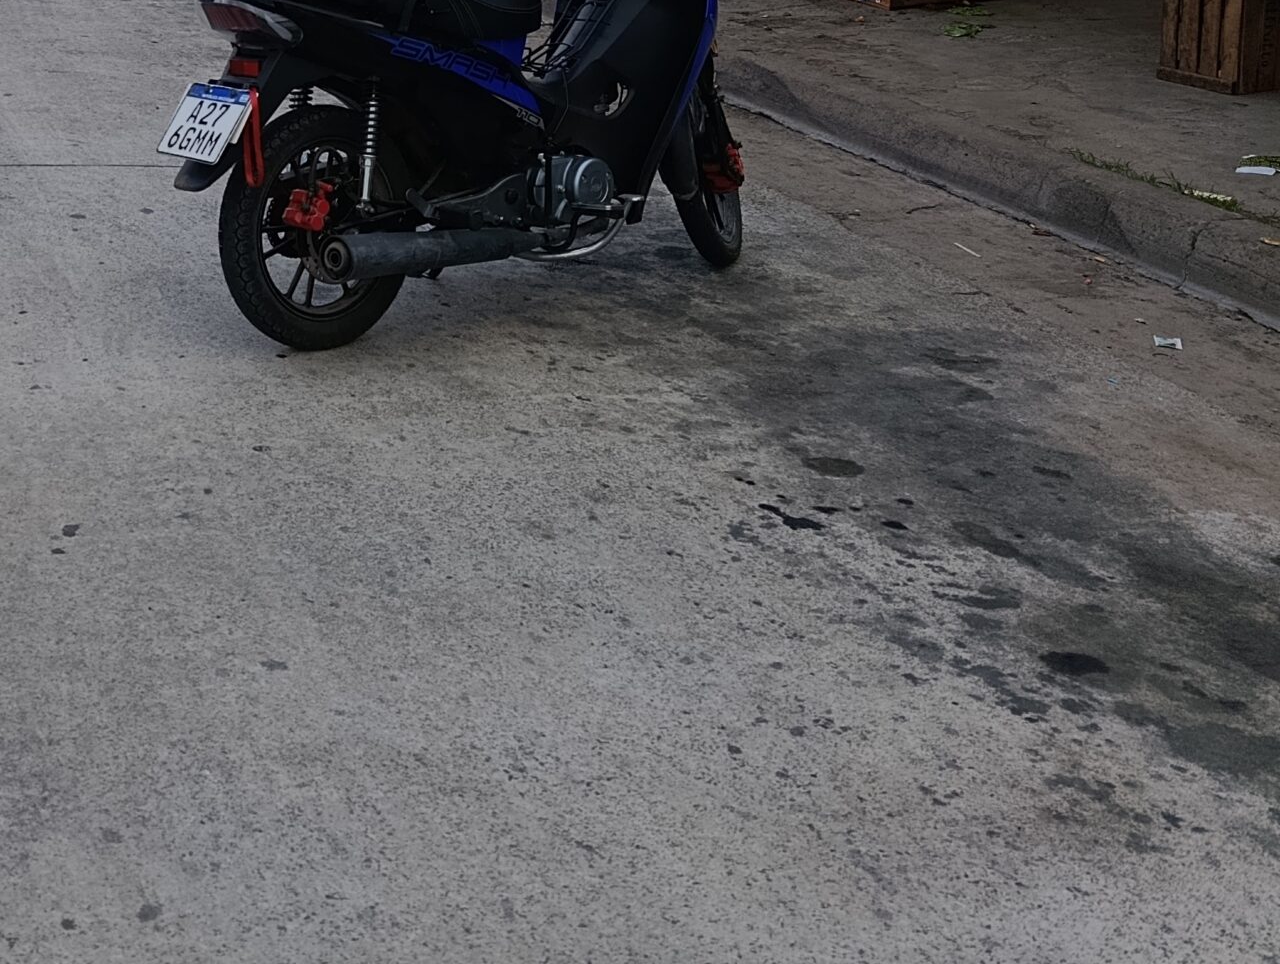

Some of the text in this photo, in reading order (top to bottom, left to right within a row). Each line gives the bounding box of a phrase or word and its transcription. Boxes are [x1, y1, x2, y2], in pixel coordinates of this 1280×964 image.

[390, 36, 512, 89] SMASH
[186, 100, 231, 127] A27
[516, 107, 541, 126] 110
[167, 125, 222, 157] 6GMM
